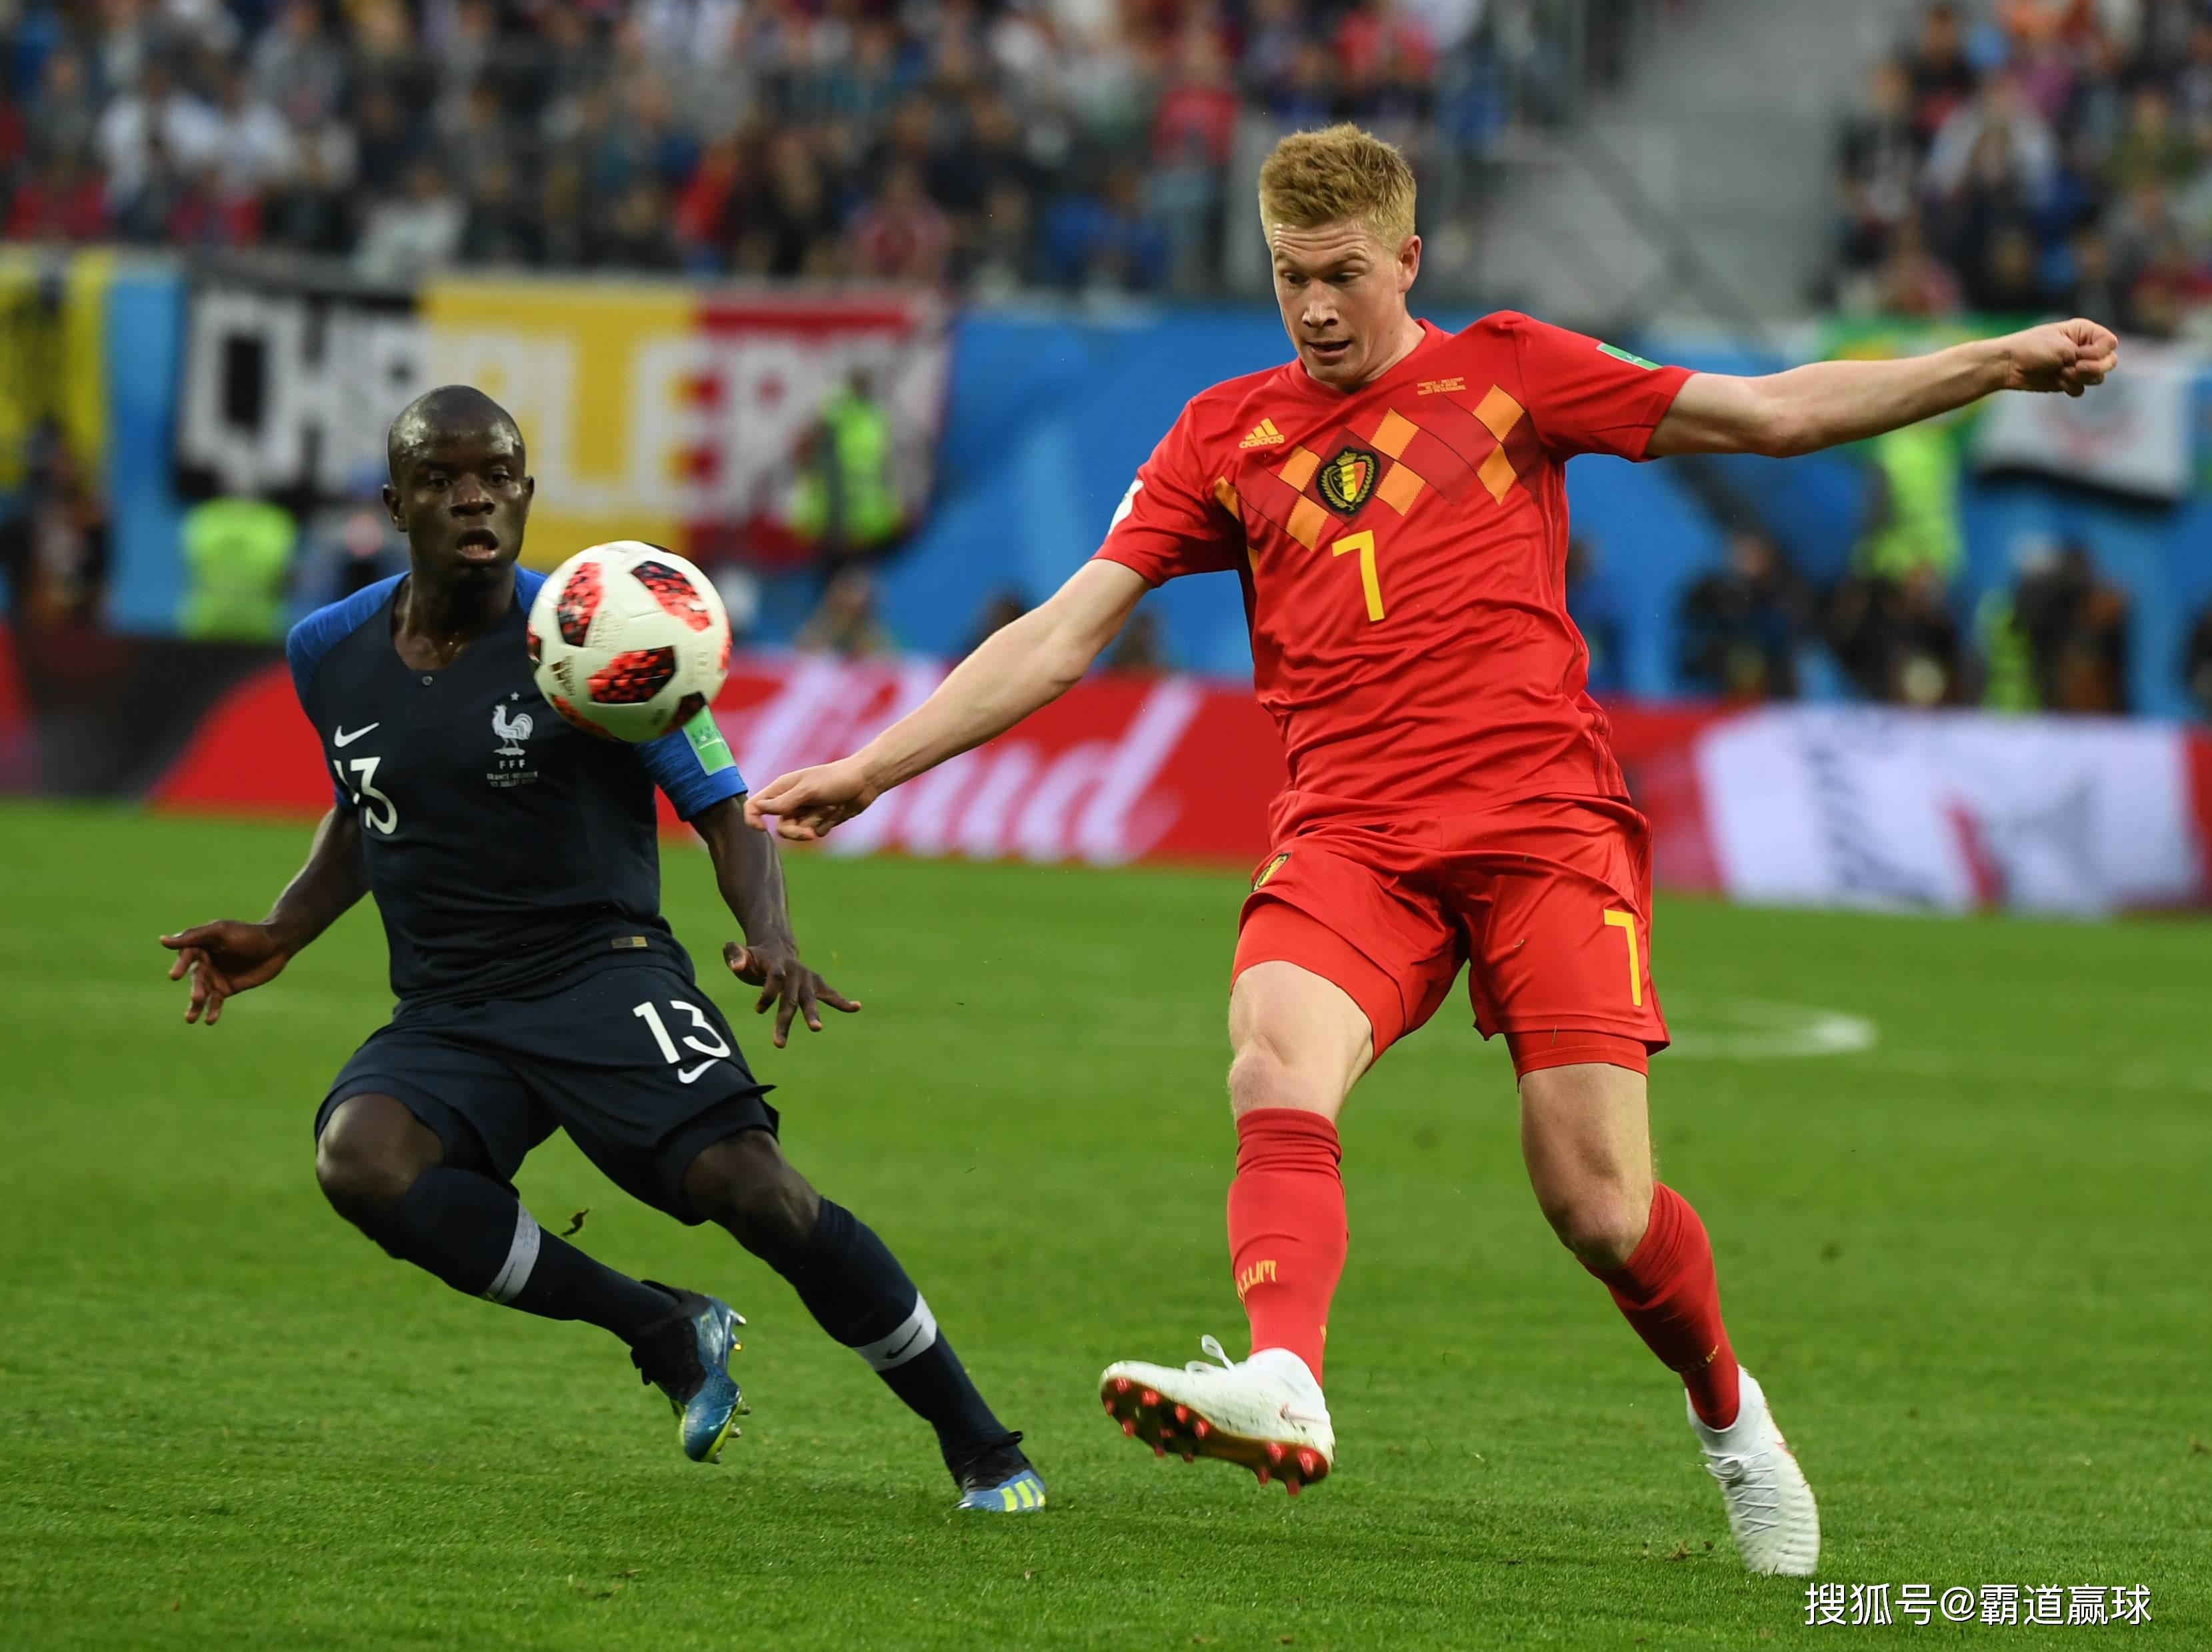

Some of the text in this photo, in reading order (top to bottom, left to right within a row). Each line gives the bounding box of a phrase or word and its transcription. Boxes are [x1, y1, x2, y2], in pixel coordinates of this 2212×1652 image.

[1239, 434, 1285, 449] adidas
[1331, 529, 1385, 621] 7
[1603, 909, 1642, 1007] 7
[632, 1000, 731, 1064] 13
